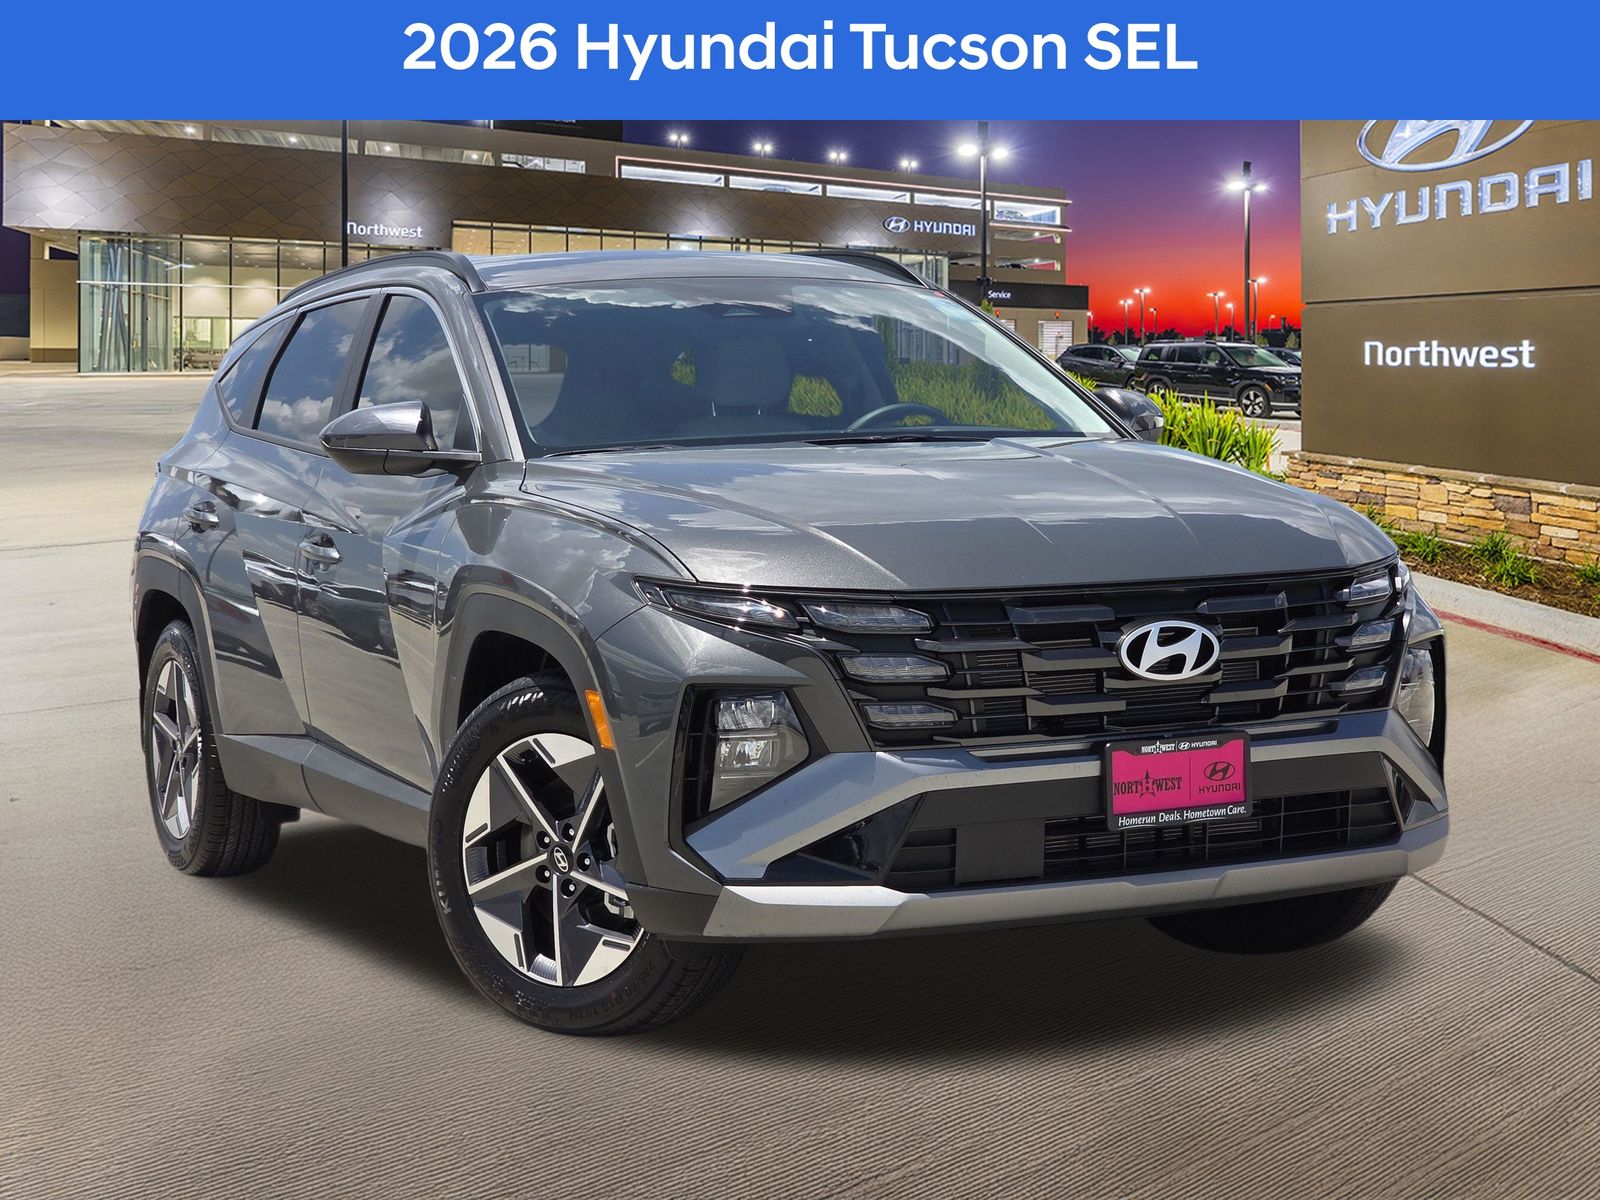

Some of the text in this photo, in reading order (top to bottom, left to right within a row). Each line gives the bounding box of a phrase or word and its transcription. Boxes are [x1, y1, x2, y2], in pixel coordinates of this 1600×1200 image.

[1326, 158, 1593, 234] HYUNDAI
[347, 221, 424, 238] Northwest
[913, 220, 977, 236] HYUNDAI
[987, 289, 1011, 299] Service
[1363, 339, 1537, 369] Northwest
[1191, 740, 1217, 748] HYUNDAI
[1199, 782, 1241, 795] HYUNDAI
[1118, 804, 1247, 826] Homerun Deals. Hometown Care.
